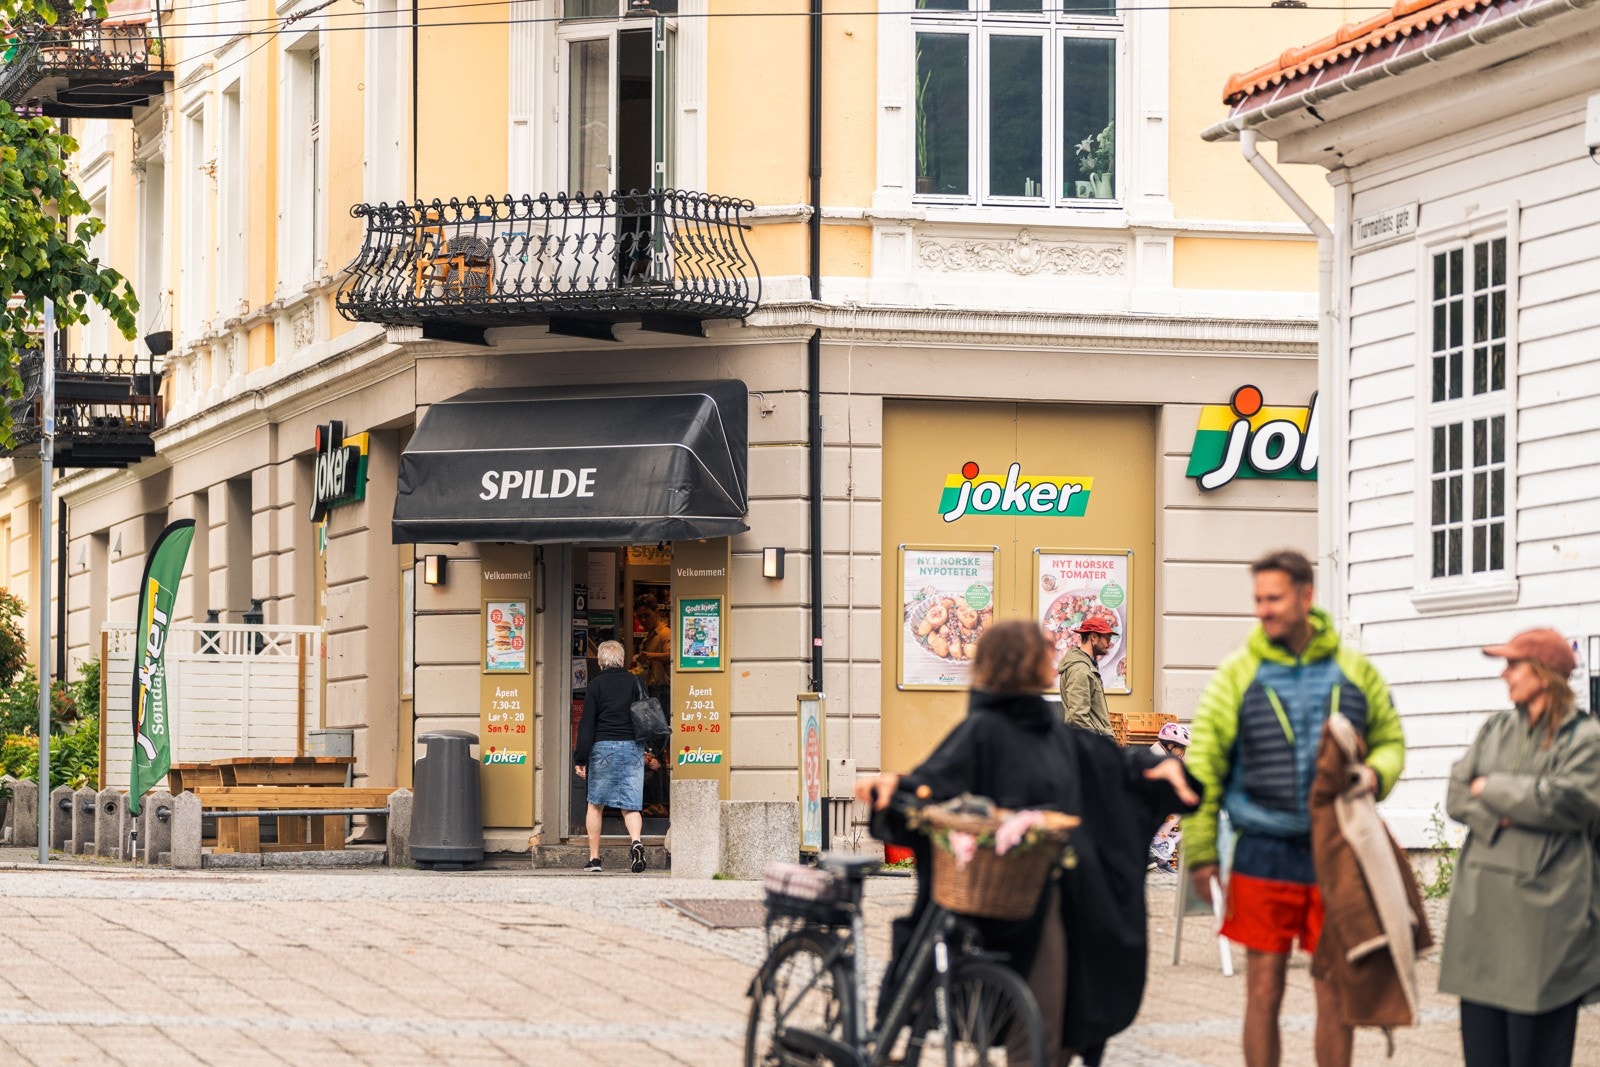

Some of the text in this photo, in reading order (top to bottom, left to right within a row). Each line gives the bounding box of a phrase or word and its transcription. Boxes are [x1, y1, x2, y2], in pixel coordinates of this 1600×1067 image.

[309, 421, 350, 522] joker
[479, 468, 597, 500] SPILDE
[943, 461, 1083, 523] joker
[917, 556, 980, 566] NYT NORSKE
[1052, 560, 1114, 569] NYT NORSKE
[483, 570, 531, 580] Velkommen!
[677, 567, 726, 577] Velkommen!
[920, 567, 978, 577] NYPOTETER
[1060, 570, 1107, 579] TOMATER
[495, 686, 518, 698] Åpent
[688, 685, 713, 697] Åpent
[492, 701, 521, 710] 7.30-21
[685, 701, 714, 709] 7.30-21
[488, 713, 501, 721] Lør
[502, 713, 508, 721] 9
[515, 713, 525, 721] 20
[681, 712, 694, 721] Lør
[696, 712, 702, 721] 9
[709, 711, 719, 720] 20
[487, 724, 502, 733] Søn
[503, 724, 509, 733] 9
[516, 724, 526, 733] 20
[680, 723, 696, 733] Søn
[697, 723, 703, 733] 9
[710, 724, 720, 733] 20
[485, 746, 524, 766] joker
[679, 745, 720, 766] joker
